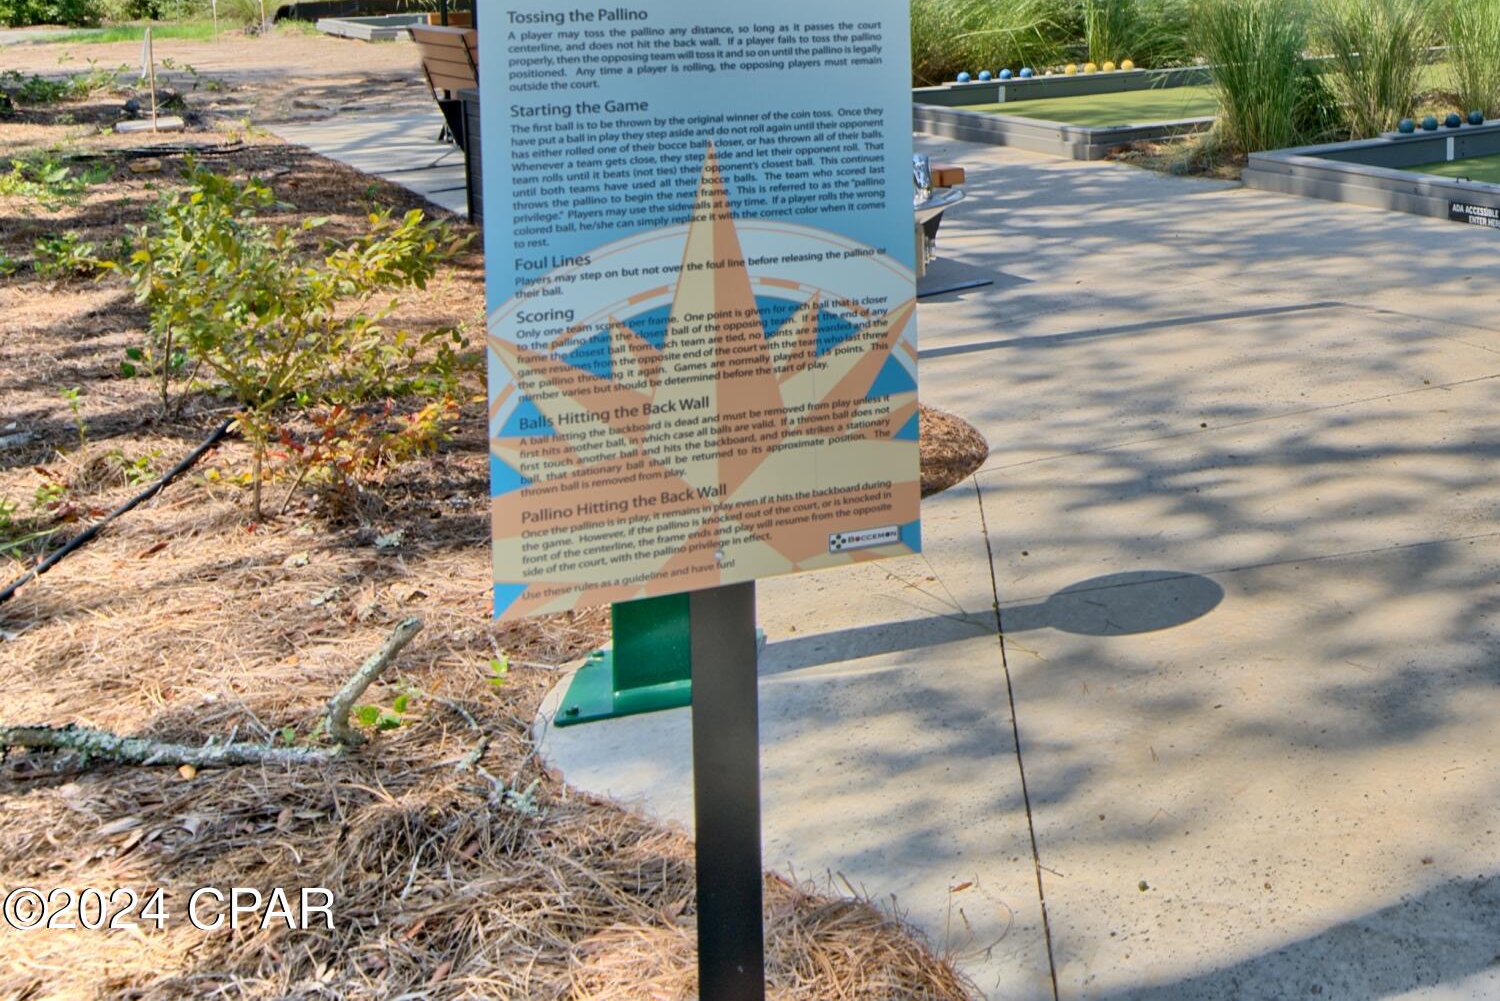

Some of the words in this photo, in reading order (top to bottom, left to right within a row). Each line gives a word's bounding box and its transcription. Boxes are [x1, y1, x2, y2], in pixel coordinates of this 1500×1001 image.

[506, 10, 565, 24] Tossing
[568, 9, 594, 22] the
[597, 7, 648, 20] Pallino
[507, 31, 516, 39] A
[520, 30, 553, 41] player
[557, 31, 580, 40] may
[583, 29, 605, 37] toss
[608, 27, 626, 36] the
[630, 28, 665, 38] pallino
[668, 28, 687, 36] any
[690, 25, 734, 34] distance,
[752, 23, 775, 34] long
[793, 23, 800, 31] it
[803, 23, 834, 32] passes
[837, 21, 854, 30] the
[856, 21, 881, 29] court
[508, 81, 548, 91] outside
[549, 80, 568, 89] the
[569, 80, 600, 88] court.
[509, 103, 572, 117] Starting
[575, 101, 601, 114] the
[603, 100, 648, 112] Game
[509, 124, 530, 133] The
[531, 123, 552, 132] first
[554, 121, 573, 131] ball
[576, 120, 584, 129] is
[585, 121, 598, 129] to
[599, 119, 613, 128] be
[614, 119, 652, 127] thrown
[653, 117, 667, 127] by
[668, 116, 685, 124] the
[686, 113, 724, 125] original
[725, 114, 759, 122] winner
[760, 110, 771, 120] of
[772, 111, 789, 119] the
[790, 109, 811, 118] coin
[836, 107, 862, 116] Once
[862, 106, 884, 116] they
[1451, 203, 1464, 212] ADA
[1464, 205, 1499, 218] ACCESSIBLE
[513, 240, 525, 248] to
[526, 238, 549, 247] rest.
[514, 256, 547, 270] Foul
[551, 255, 592, 268] Lines
[514, 276, 552, 286] Players
[553, 274, 577, 283] may
[579, 271, 602, 281] step
[604, 270, 619, 278] on
[620, 267, 639, 276] but
[641, 265, 659, 274] not
[661, 263, 684, 273] over
[686, 261, 703, 270] the
[705, 259, 725, 268] foul
[727, 258, 745, 266] line
[747, 255, 779, 265] before
[781, 252, 823, 262] releasing
[825, 250, 841, 259] the
[843, 248, 875, 259] pallino
[514, 288, 540, 298] their
[541, 286, 564, 296] ball.
[515, 309, 574, 324] Scoring
[538, 376, 574, 389] pallino
[577, 371, 623, 382] throwing
[636, 365, 667, 377] again.
[673, 362, 707, 371] Games
[709, 360, 725, 368] are
[728, 354, 770, 366] normally
[772, 349, 804, 363] played
[834, 345, 865, 356] points.
[561, 388, 591, 396] varies
[593, 384, 611, 393] but
[613, 379, 647, 390] should
[648, 378, 663, 388] be
[663, 371, 721, 385] determined
[722, 368, 754, 378] before
[755, 365, 771, 374] the
[772, 364, 794, 373] start
[795, 361, 806, 371] of
[806, 360, 829, 371] play.
[519, 415, 553, 430] Balls
[557, 410, 610, 425] Hitting
[613, 405, 639, 418] the
[642, 400, 677, 415] Back
[678, 395, 709, 410] Wall
[520, 485, 558, 496] thrown
[560, 480, 579, 491] ball
[581, 480, 590, 488] is
[591, 473, 636, 486] removed
[637, 471, 662, 480] from
[663, 468, 687, 479] play.
[521, 508, 573, 523] Pallino
[576, 499, 629, 516] Hitting
[631, 494, 657, 508] the
[660, 488, 694, 504] Back
[696, 483, 727, 498] Wall
[522, 566, 544, 576] side
[545, 563, 557, 573] of
[558, 562, 576, 570] the
[577, 557, 608, 568] court,
[609, 552, 632, 563] with
[633, 550, 651, 559] the
[652, 545, 687, 558] pallino
[688, 539, 731, 552] privilege
[731, 536, 742, 544] in
[742, 532, 772, 543] effect.
[521, 591, 541, 600] Use
[542, 586, 572, 596] these
[573, 581, 599, 592] rules
[599, 579, 612, 588] as
[613, 578, 620, 586] a
[621, 571, 668, 586] guideline
[670, 565, 689, 576] and
[690, 564, 714, 573] have
[715, 558, 735, 569] fun!
